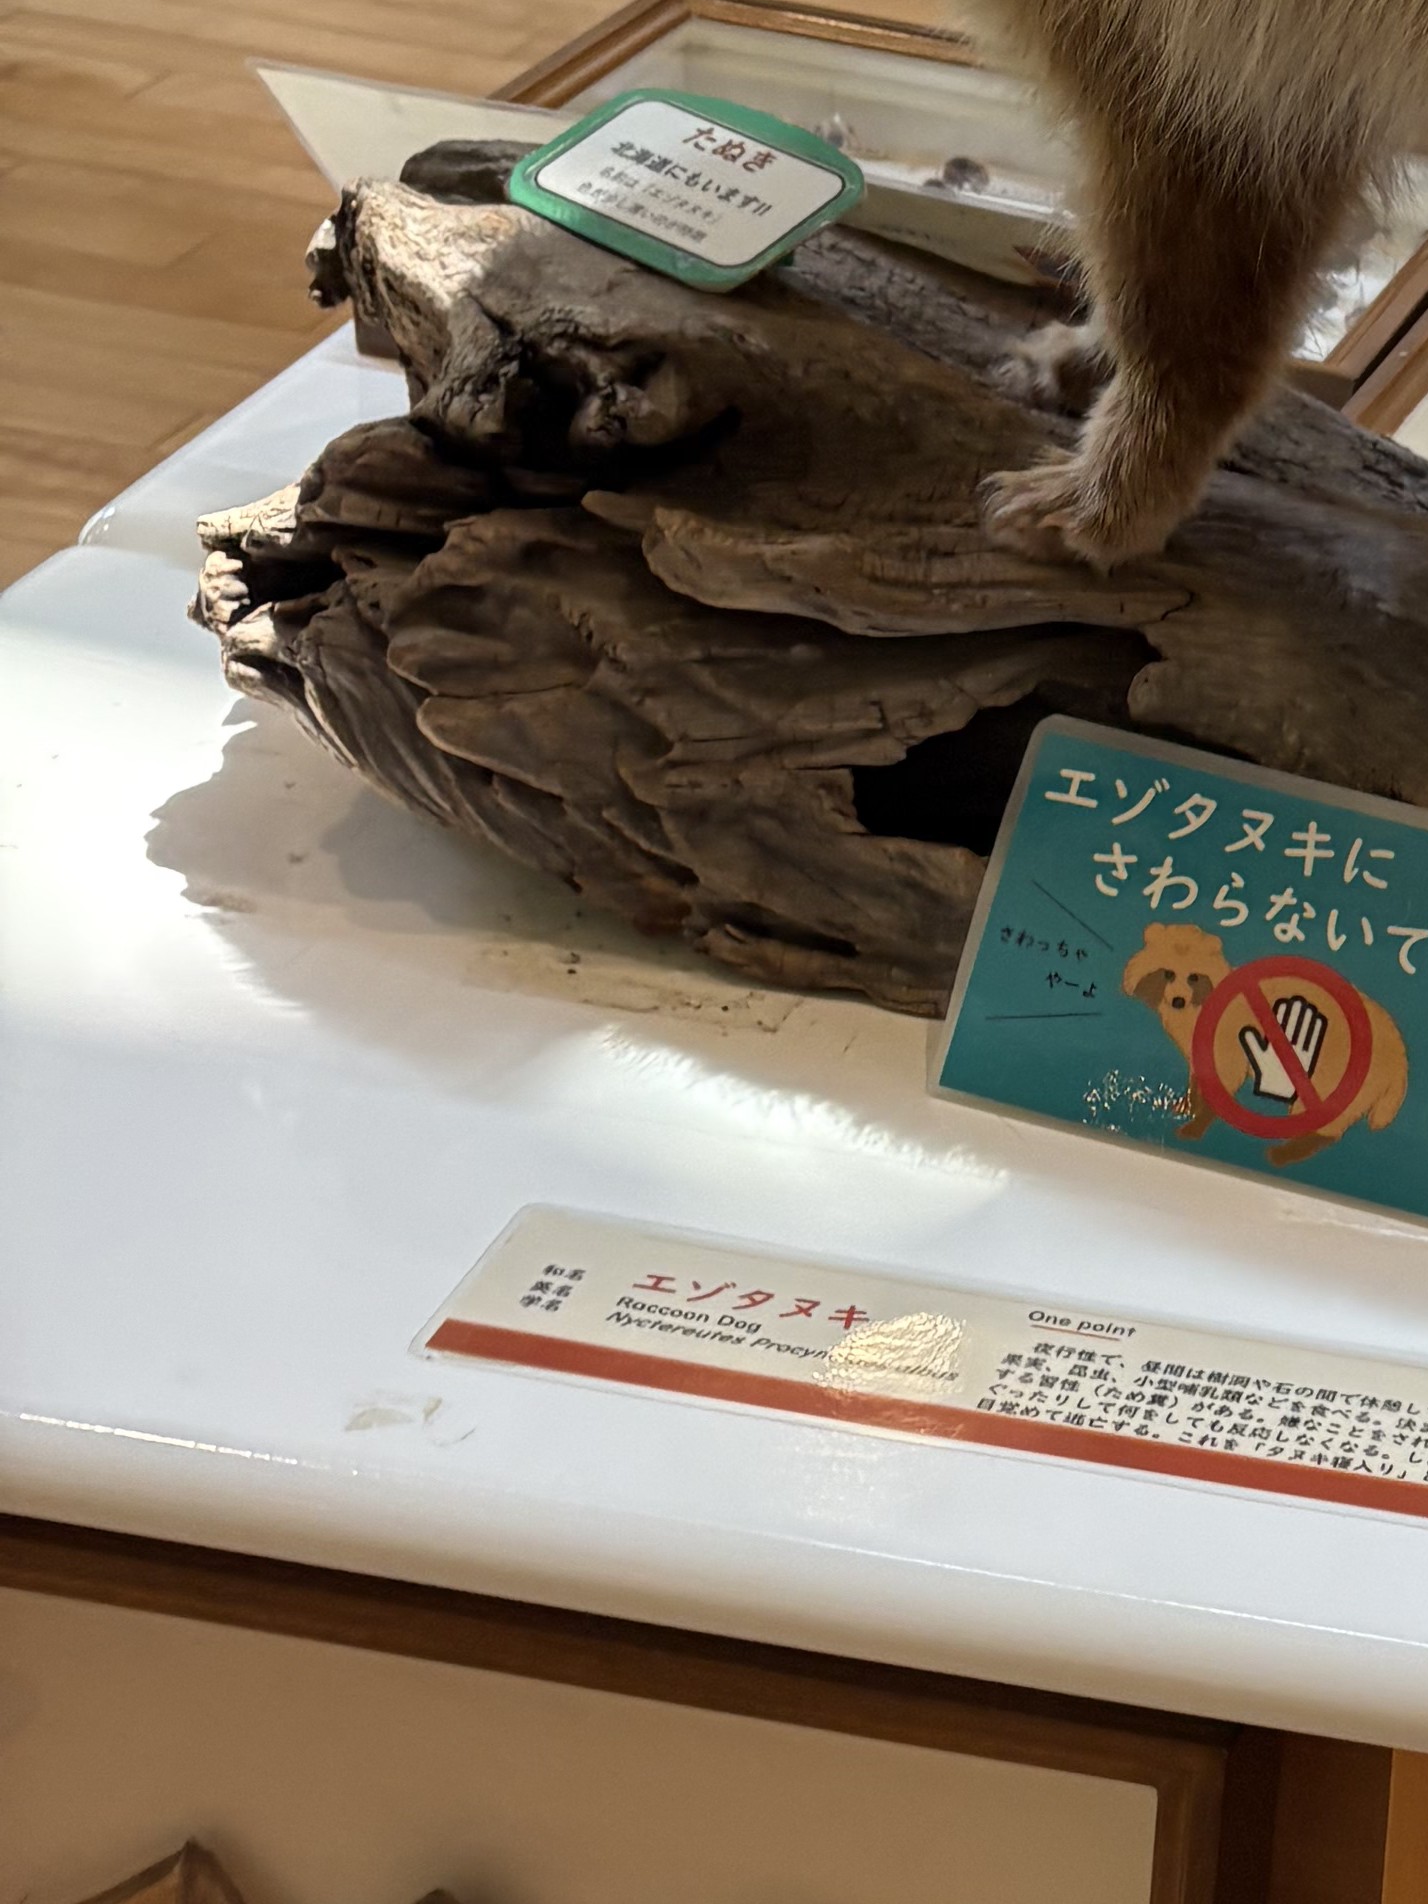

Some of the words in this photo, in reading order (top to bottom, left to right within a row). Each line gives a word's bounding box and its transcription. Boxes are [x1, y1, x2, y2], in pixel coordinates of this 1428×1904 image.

[682, 126, 778, 173] たぬき
[1045, 769, 1395, 890] エゾタヌキに
[1000, 926, 1088, 961] さわっちゃ
[1046, 972, 1098, 1000] やーよ
[543, 1264, 587, 1281] 和名
[632, 1273, 870, 1330] エゾタヌキ
[616, 1296, 710, 1323] Raccoon
[717, 1314, 762, 1334] Dog
[605, 1311, 745, 1346] Nyctereutes
[1028, 1309, 1070, 1328] One
[1077, 1317, 1136, 1340] point
